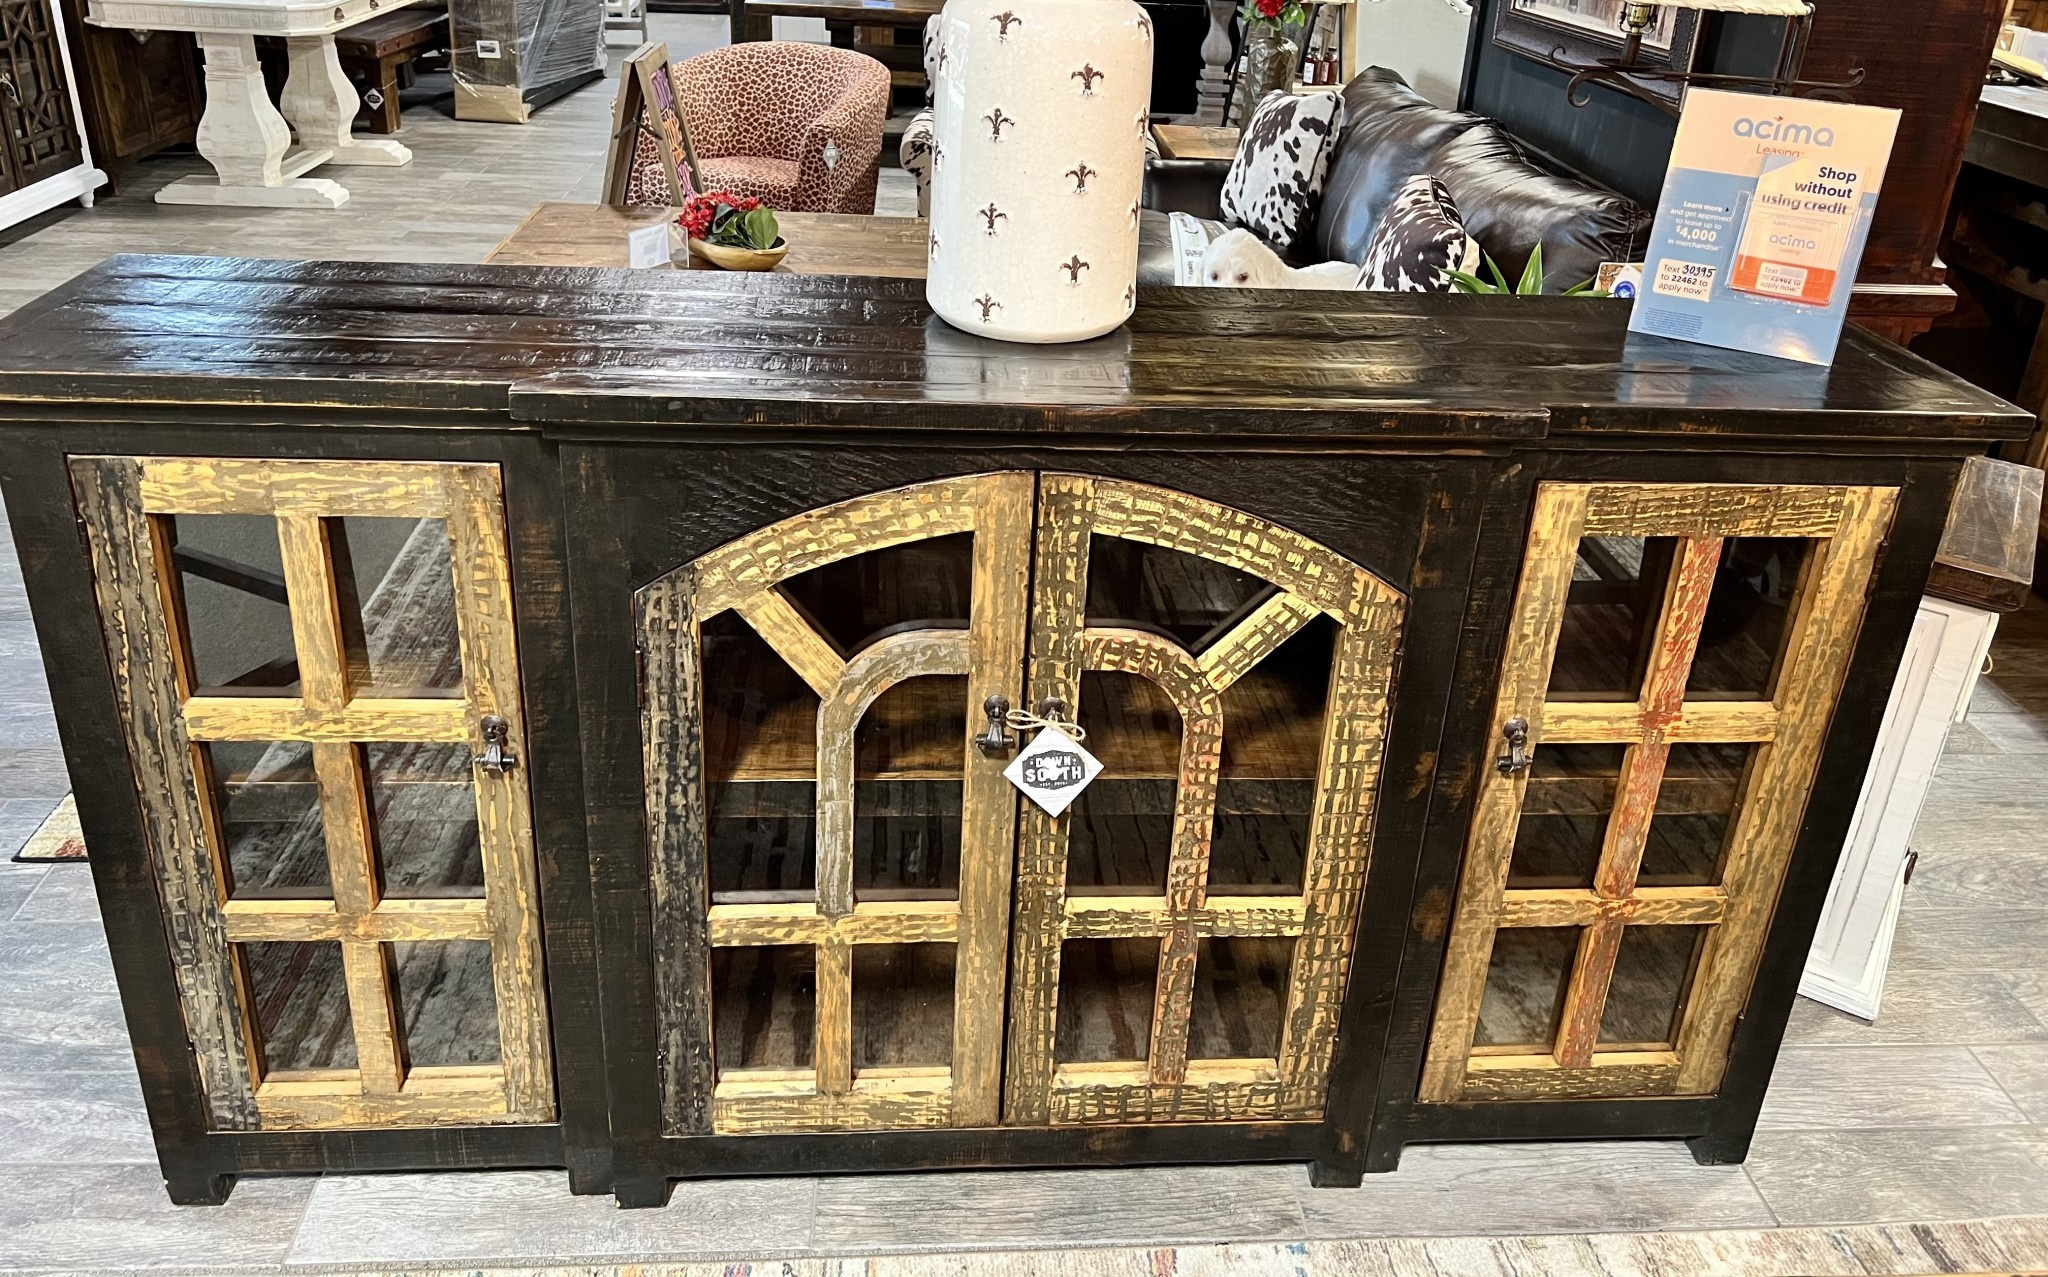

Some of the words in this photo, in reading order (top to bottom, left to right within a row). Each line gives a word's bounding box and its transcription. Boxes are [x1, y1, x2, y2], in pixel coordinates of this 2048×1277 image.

[1733, 116, 1835, 147] acima
[1818, 166, 1857, 184] Shop
[1795, 181, 1852, 199] without
[1683, 200, 1703, 210] Learn
[1703, 204, 1723, 213] more
[1761, 194, 1801, 210] using
[1804, 201, 1847, 216] credit
[1670, 208, 1684, 216] and
[1697, 212, 1732, 223] approved
[1684, 219, 1703, 227] lease
[1703, 222, 1713, 230] up
[1675, 225, 1717, 242] $4,000
[1675, 239, 1719, 251] merchandise
[1769, 234, 1816, 250] acima
[1664, 263, 1680, 274] Text
[1681, 264, 1716, 278] 30395
[1764, 266, 1778, 275] Text
[1661, 273, 1670, 281] to
[1671, 274, 1698, 286] 22462
[1699, 279, 1708, 287] to
[1759, 281, 1779, 291] apply
[1780, 284, 1797, 293] now.
[1658, 282, 1682, 293] apply
[1683, 286, 1703, 296] now.
[1025, 765, 1082, 783] SOUTH
